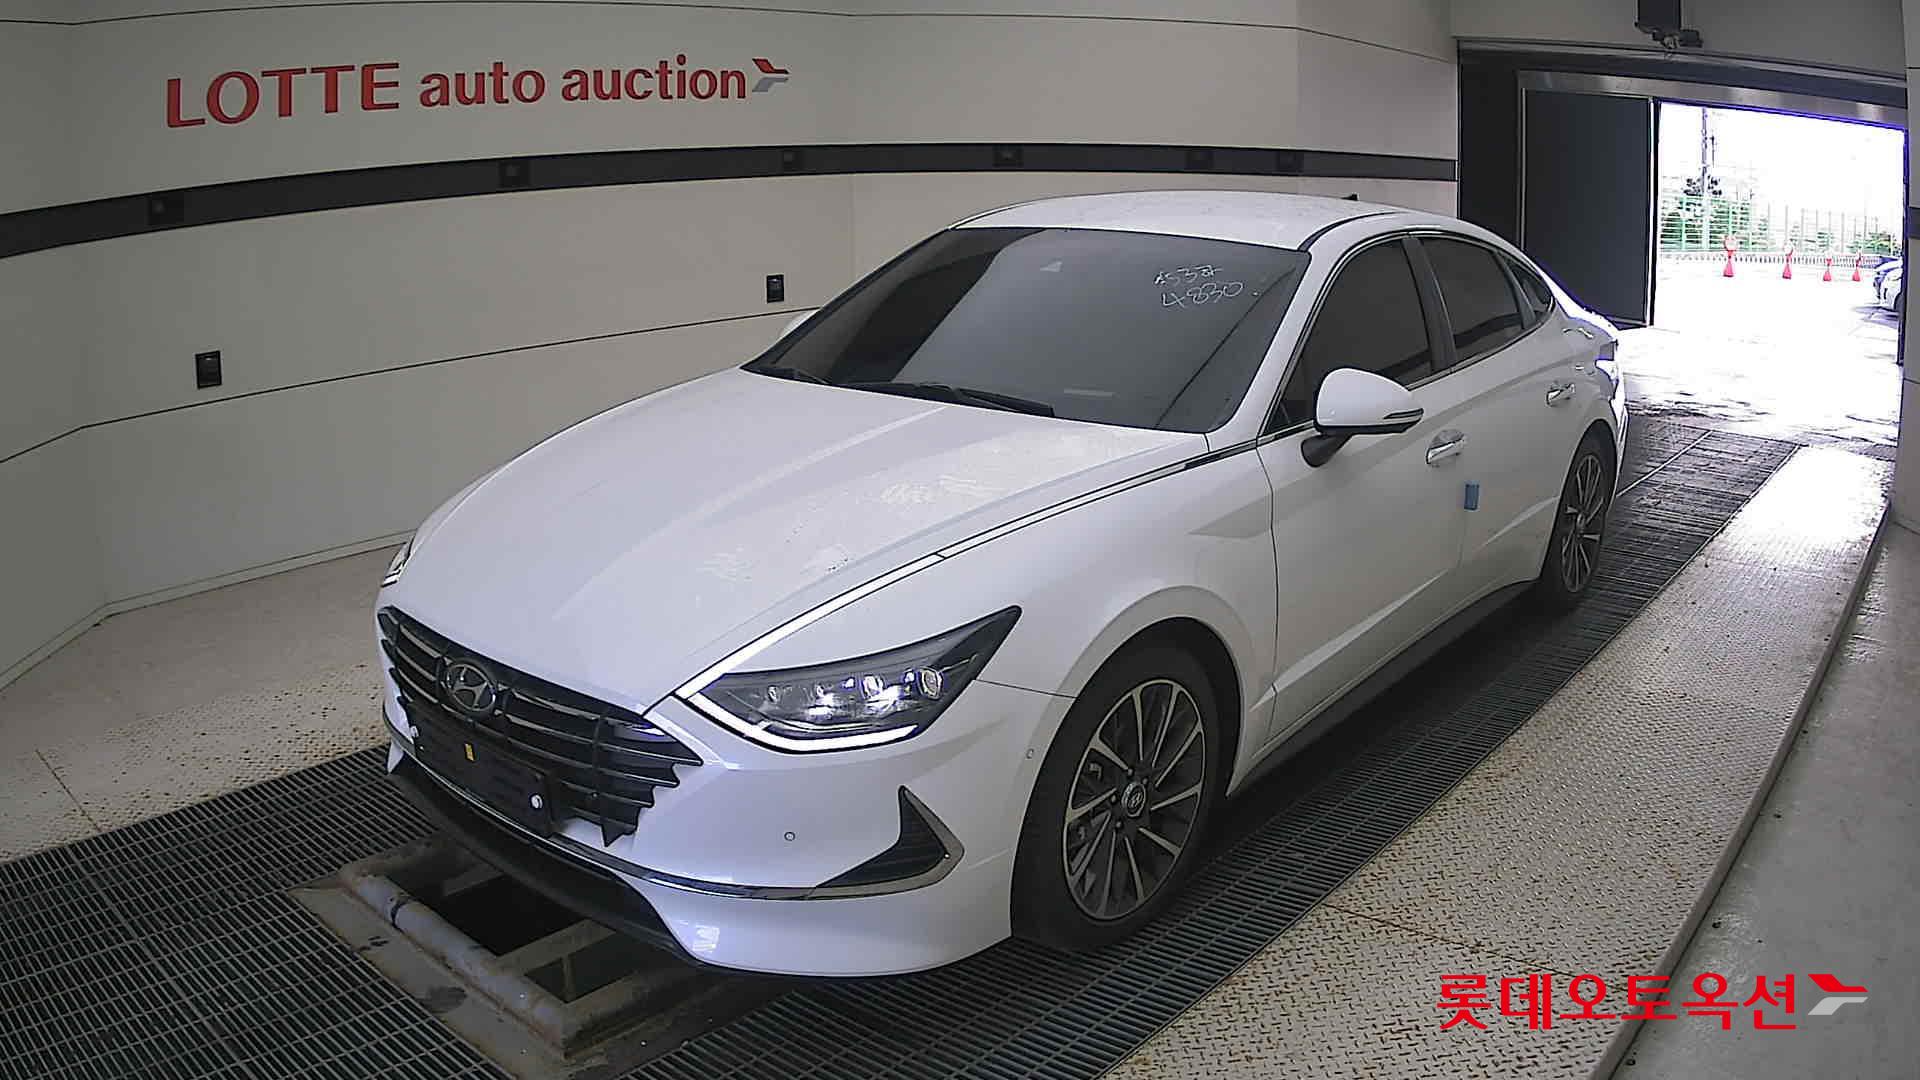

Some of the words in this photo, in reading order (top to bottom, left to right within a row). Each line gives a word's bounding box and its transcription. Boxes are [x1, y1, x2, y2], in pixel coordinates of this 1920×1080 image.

[167, 63, 400, 127] LOTTE
[420, 62, 545, 107] auto
[561, 54, 747, 101] auction
